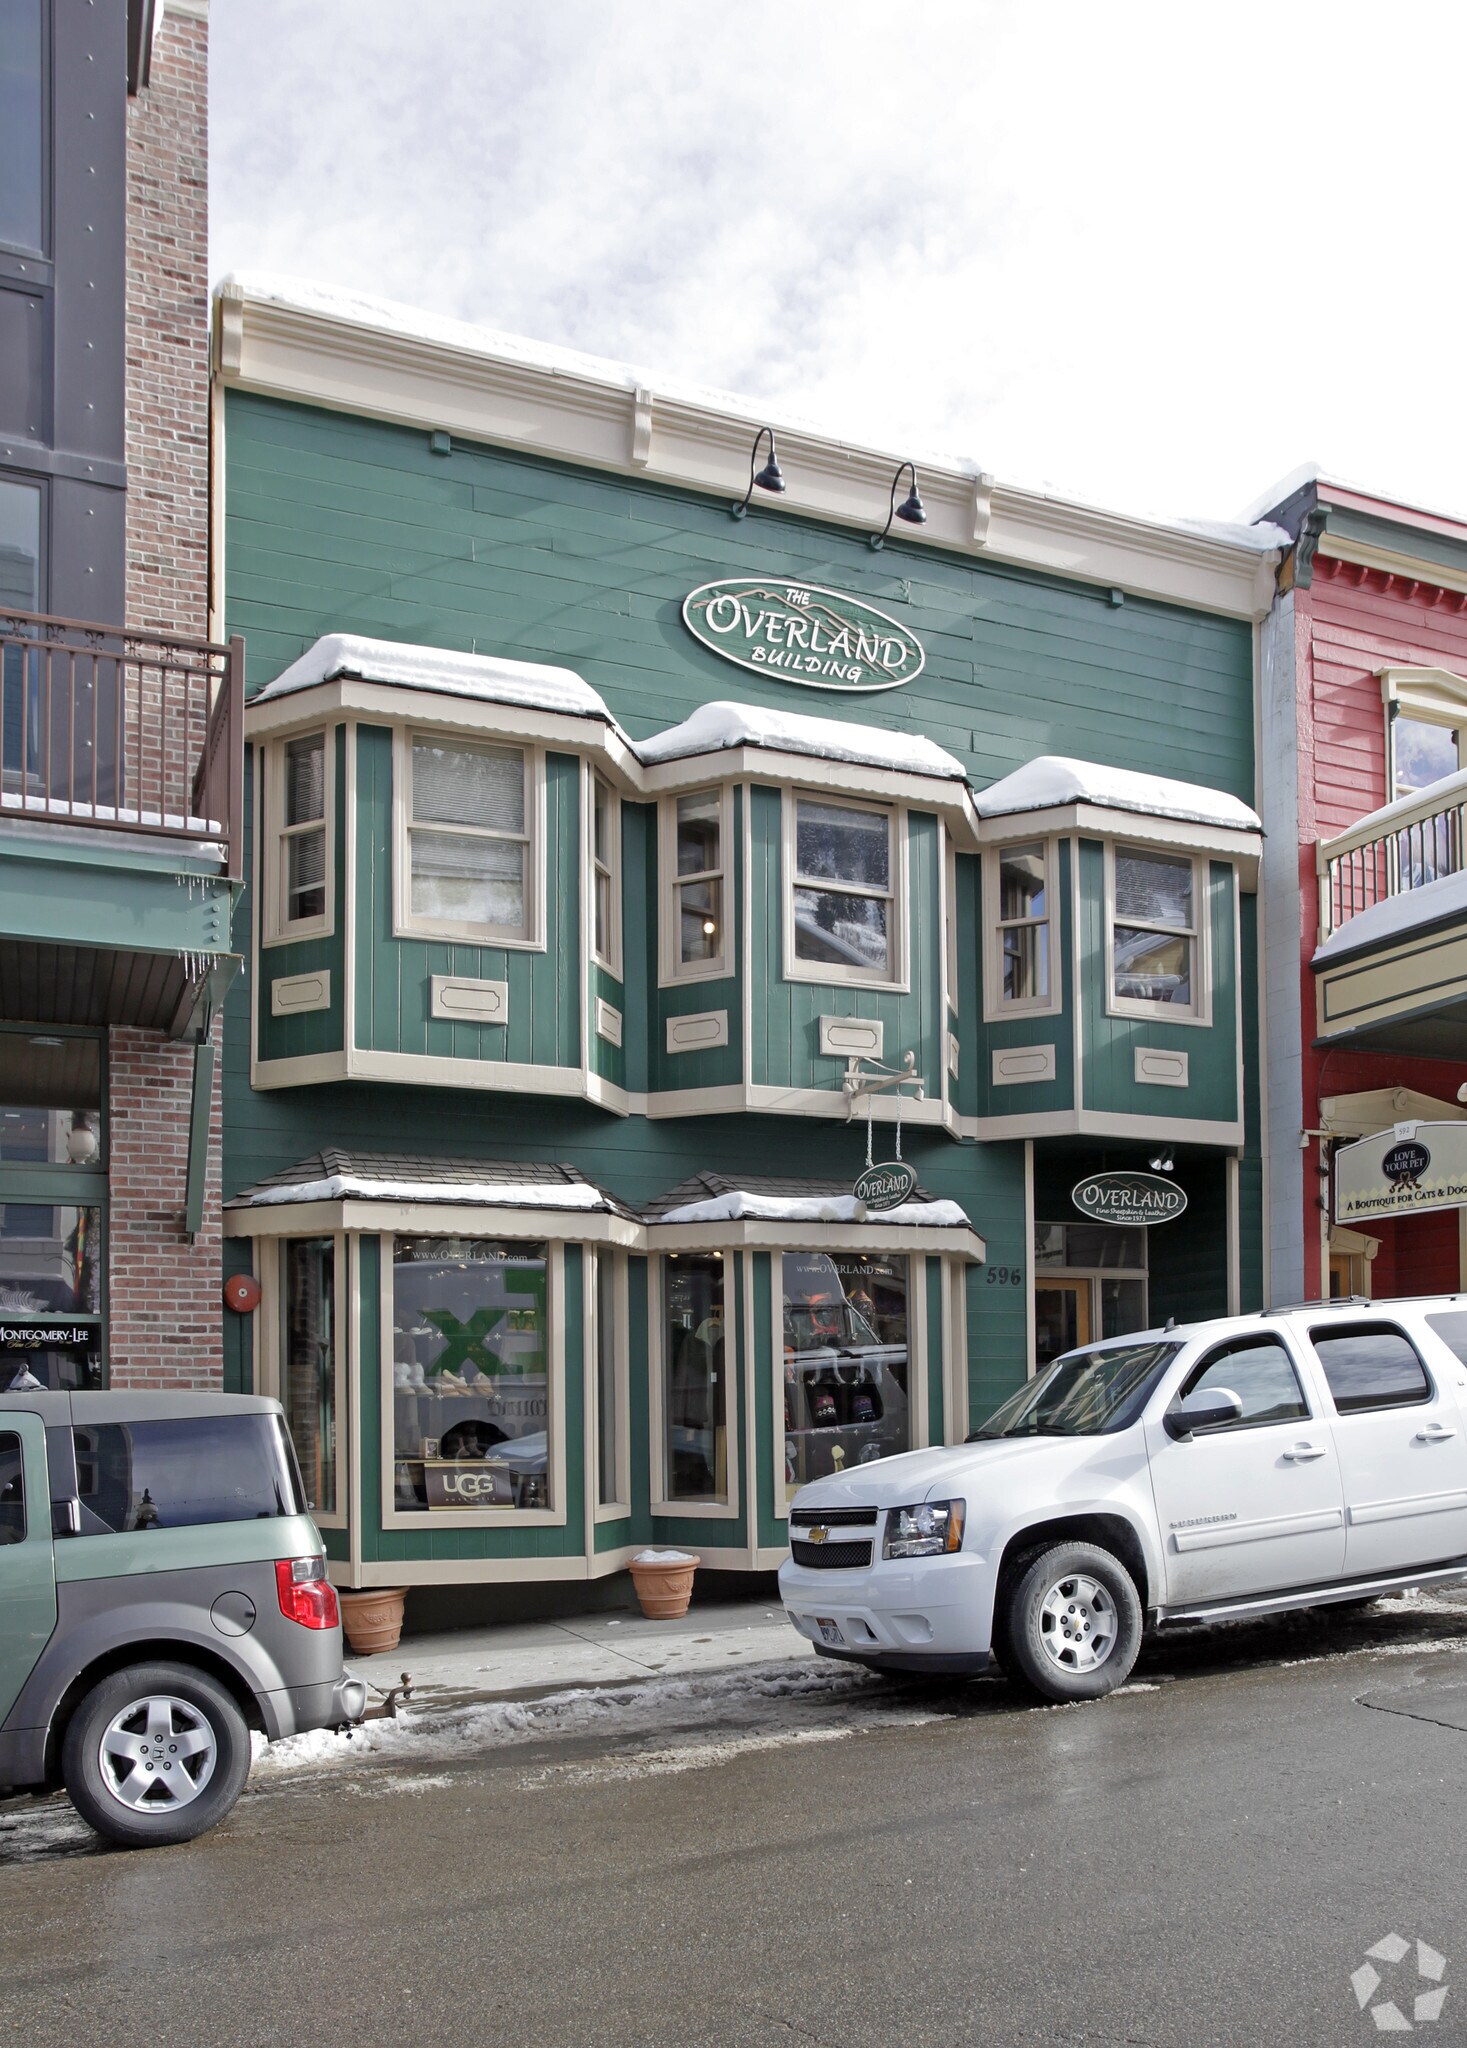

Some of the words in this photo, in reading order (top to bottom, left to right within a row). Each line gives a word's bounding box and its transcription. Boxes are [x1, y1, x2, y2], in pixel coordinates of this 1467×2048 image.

[786, 588, 810, 605] THE
[705, 595, 907, 668] OVERLAND
[751, 645, 862, 683] BUILDING
[1385, 1161, 1408, 1172] YOUR
[1410, 1158, 1425, 1168] PET
[1394, 1150, 1416, 1161] LOVE
[857, 1174, 909, 1199] OVERLAND
[1082, 1184, 1179, 1209] OVERLAND
[1347, 1202, 1353, 1211] A
[1355, 1197, 1396, 1209] BOUTIQUE
[1397, 1194, 1413, 1204] FOR
[1414, 1190, 1436, 1201] CATS
[1437, 1188, 1445, 1197] &
[986, 1266, 1021, 1286] 596
[442, 1473, 494, 1497] UGG
[1168, 1512, 1238, 1529] SUBURBAN
